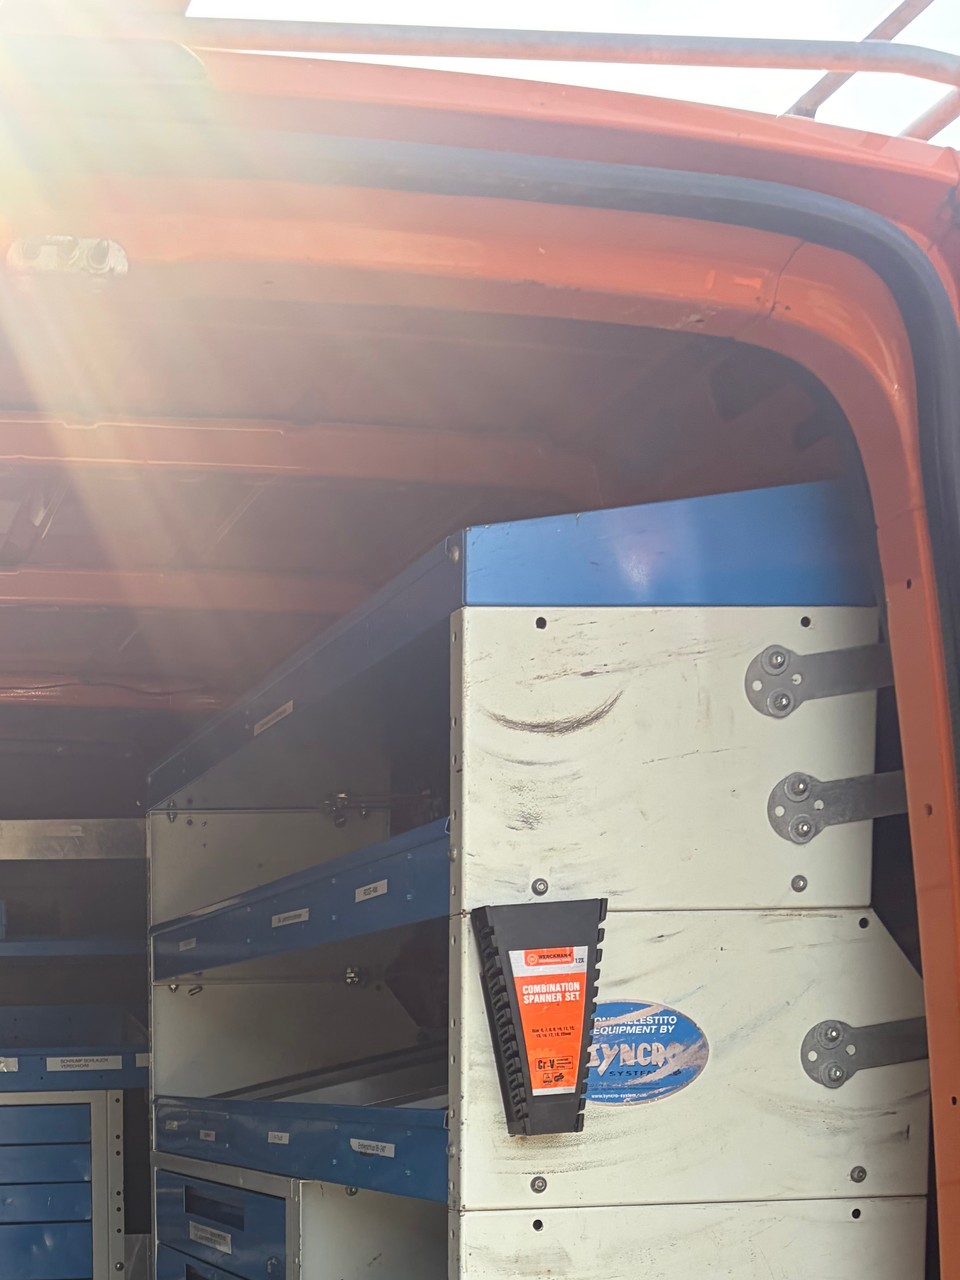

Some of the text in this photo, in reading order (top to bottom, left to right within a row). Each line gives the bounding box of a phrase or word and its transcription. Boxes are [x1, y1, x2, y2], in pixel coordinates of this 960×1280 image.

[522, 981, 581, 995] COMBINATION
[523, 991, 581, 1005] SPANNER SET
[620, 1015, 678, 1026] LESTITO
[593, 1025, 676, 1035] EQUIPMENT BY
